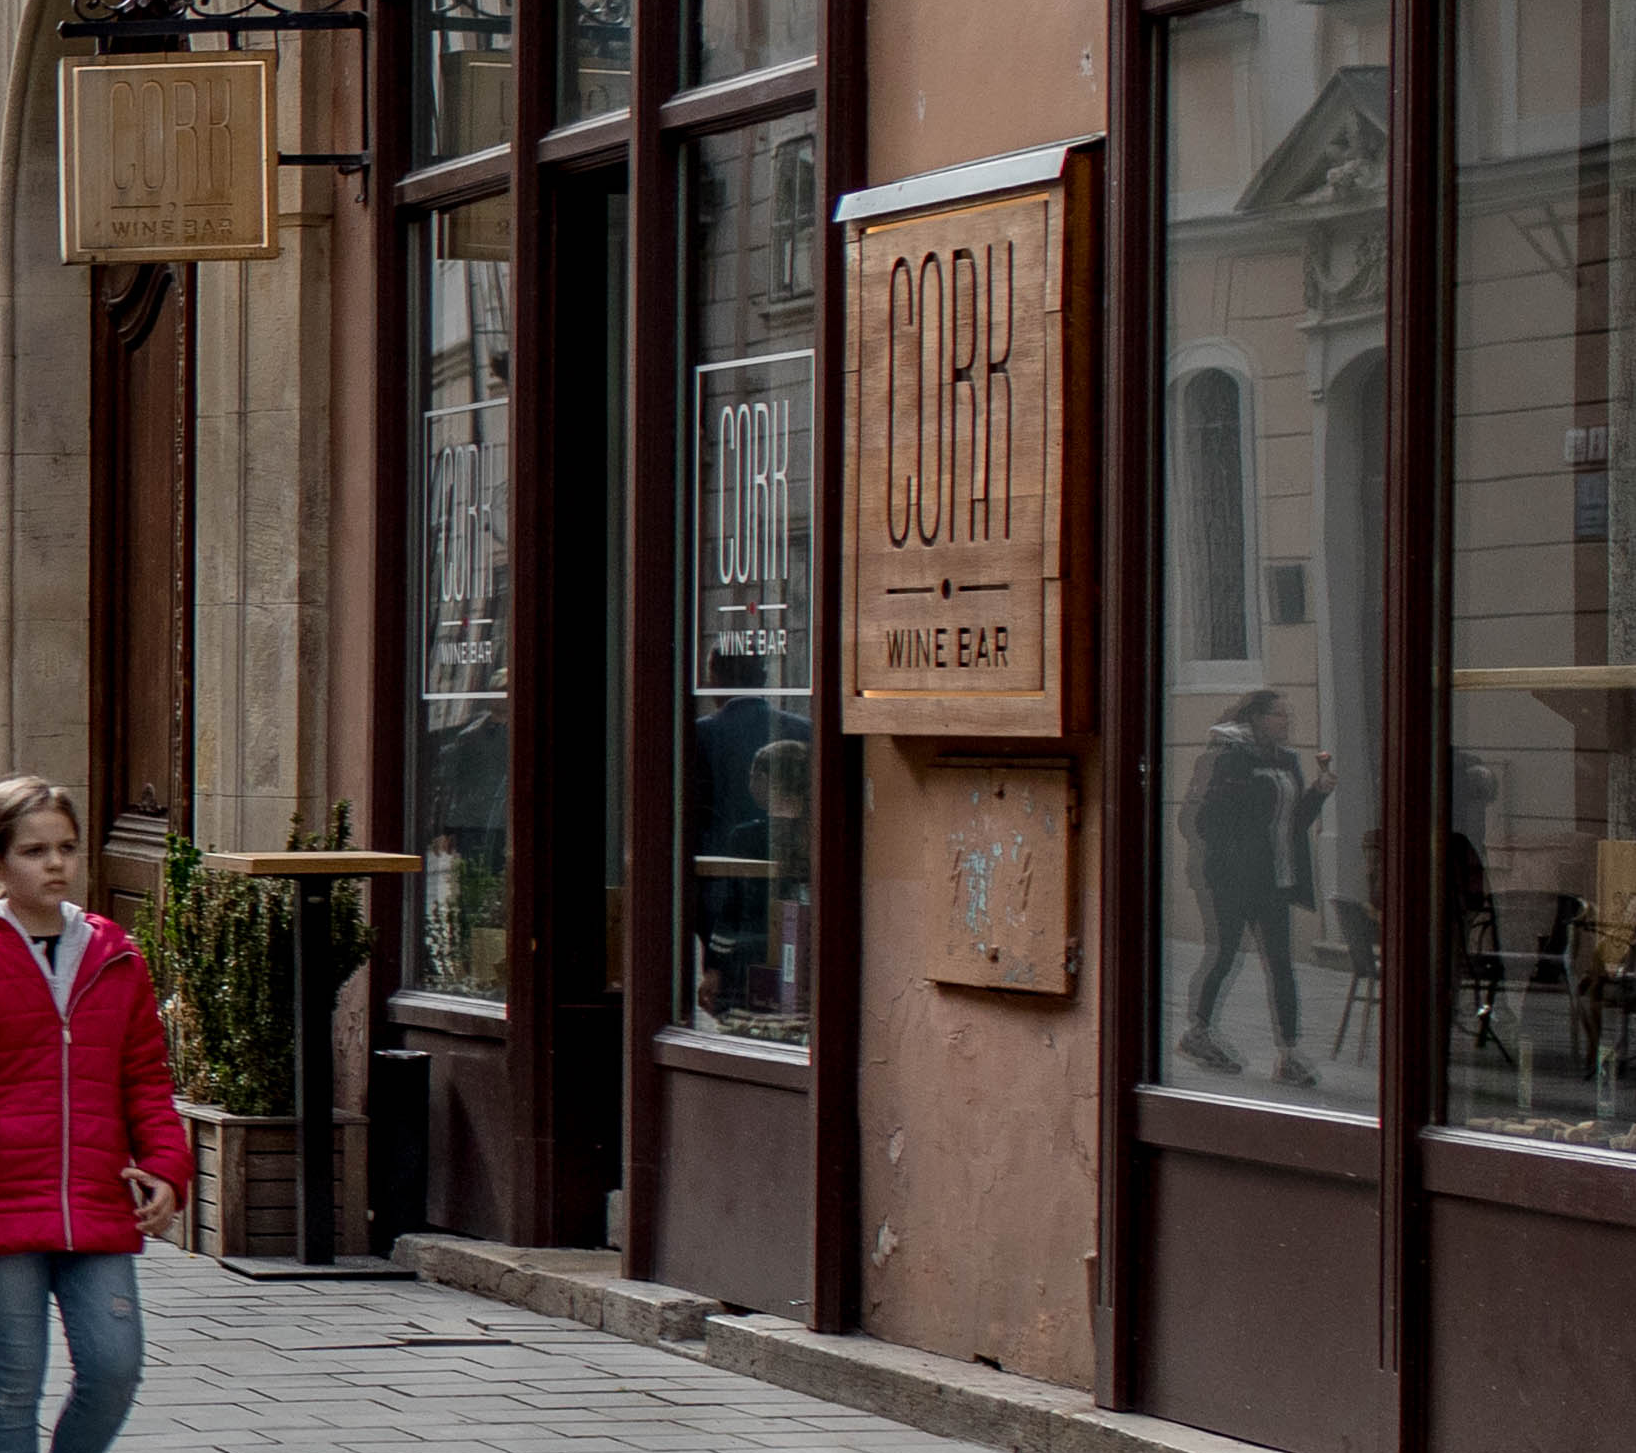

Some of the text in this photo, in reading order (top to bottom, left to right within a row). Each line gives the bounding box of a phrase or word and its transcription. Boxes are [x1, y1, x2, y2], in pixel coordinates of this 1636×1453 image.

[110, 78, 234, 191] CORK
[111, 218, 233, 240] WINE BAR
[887, 240, 1013, 548] CORK
[441, 443, 493, 601] CORK
[719, 399, 789, 584] CORK
[441, 641, 493, 664] WINE BAR
[719, 629, 787, 656] WINE BAR
[887, 626, 1009, 668] WINE BAR
